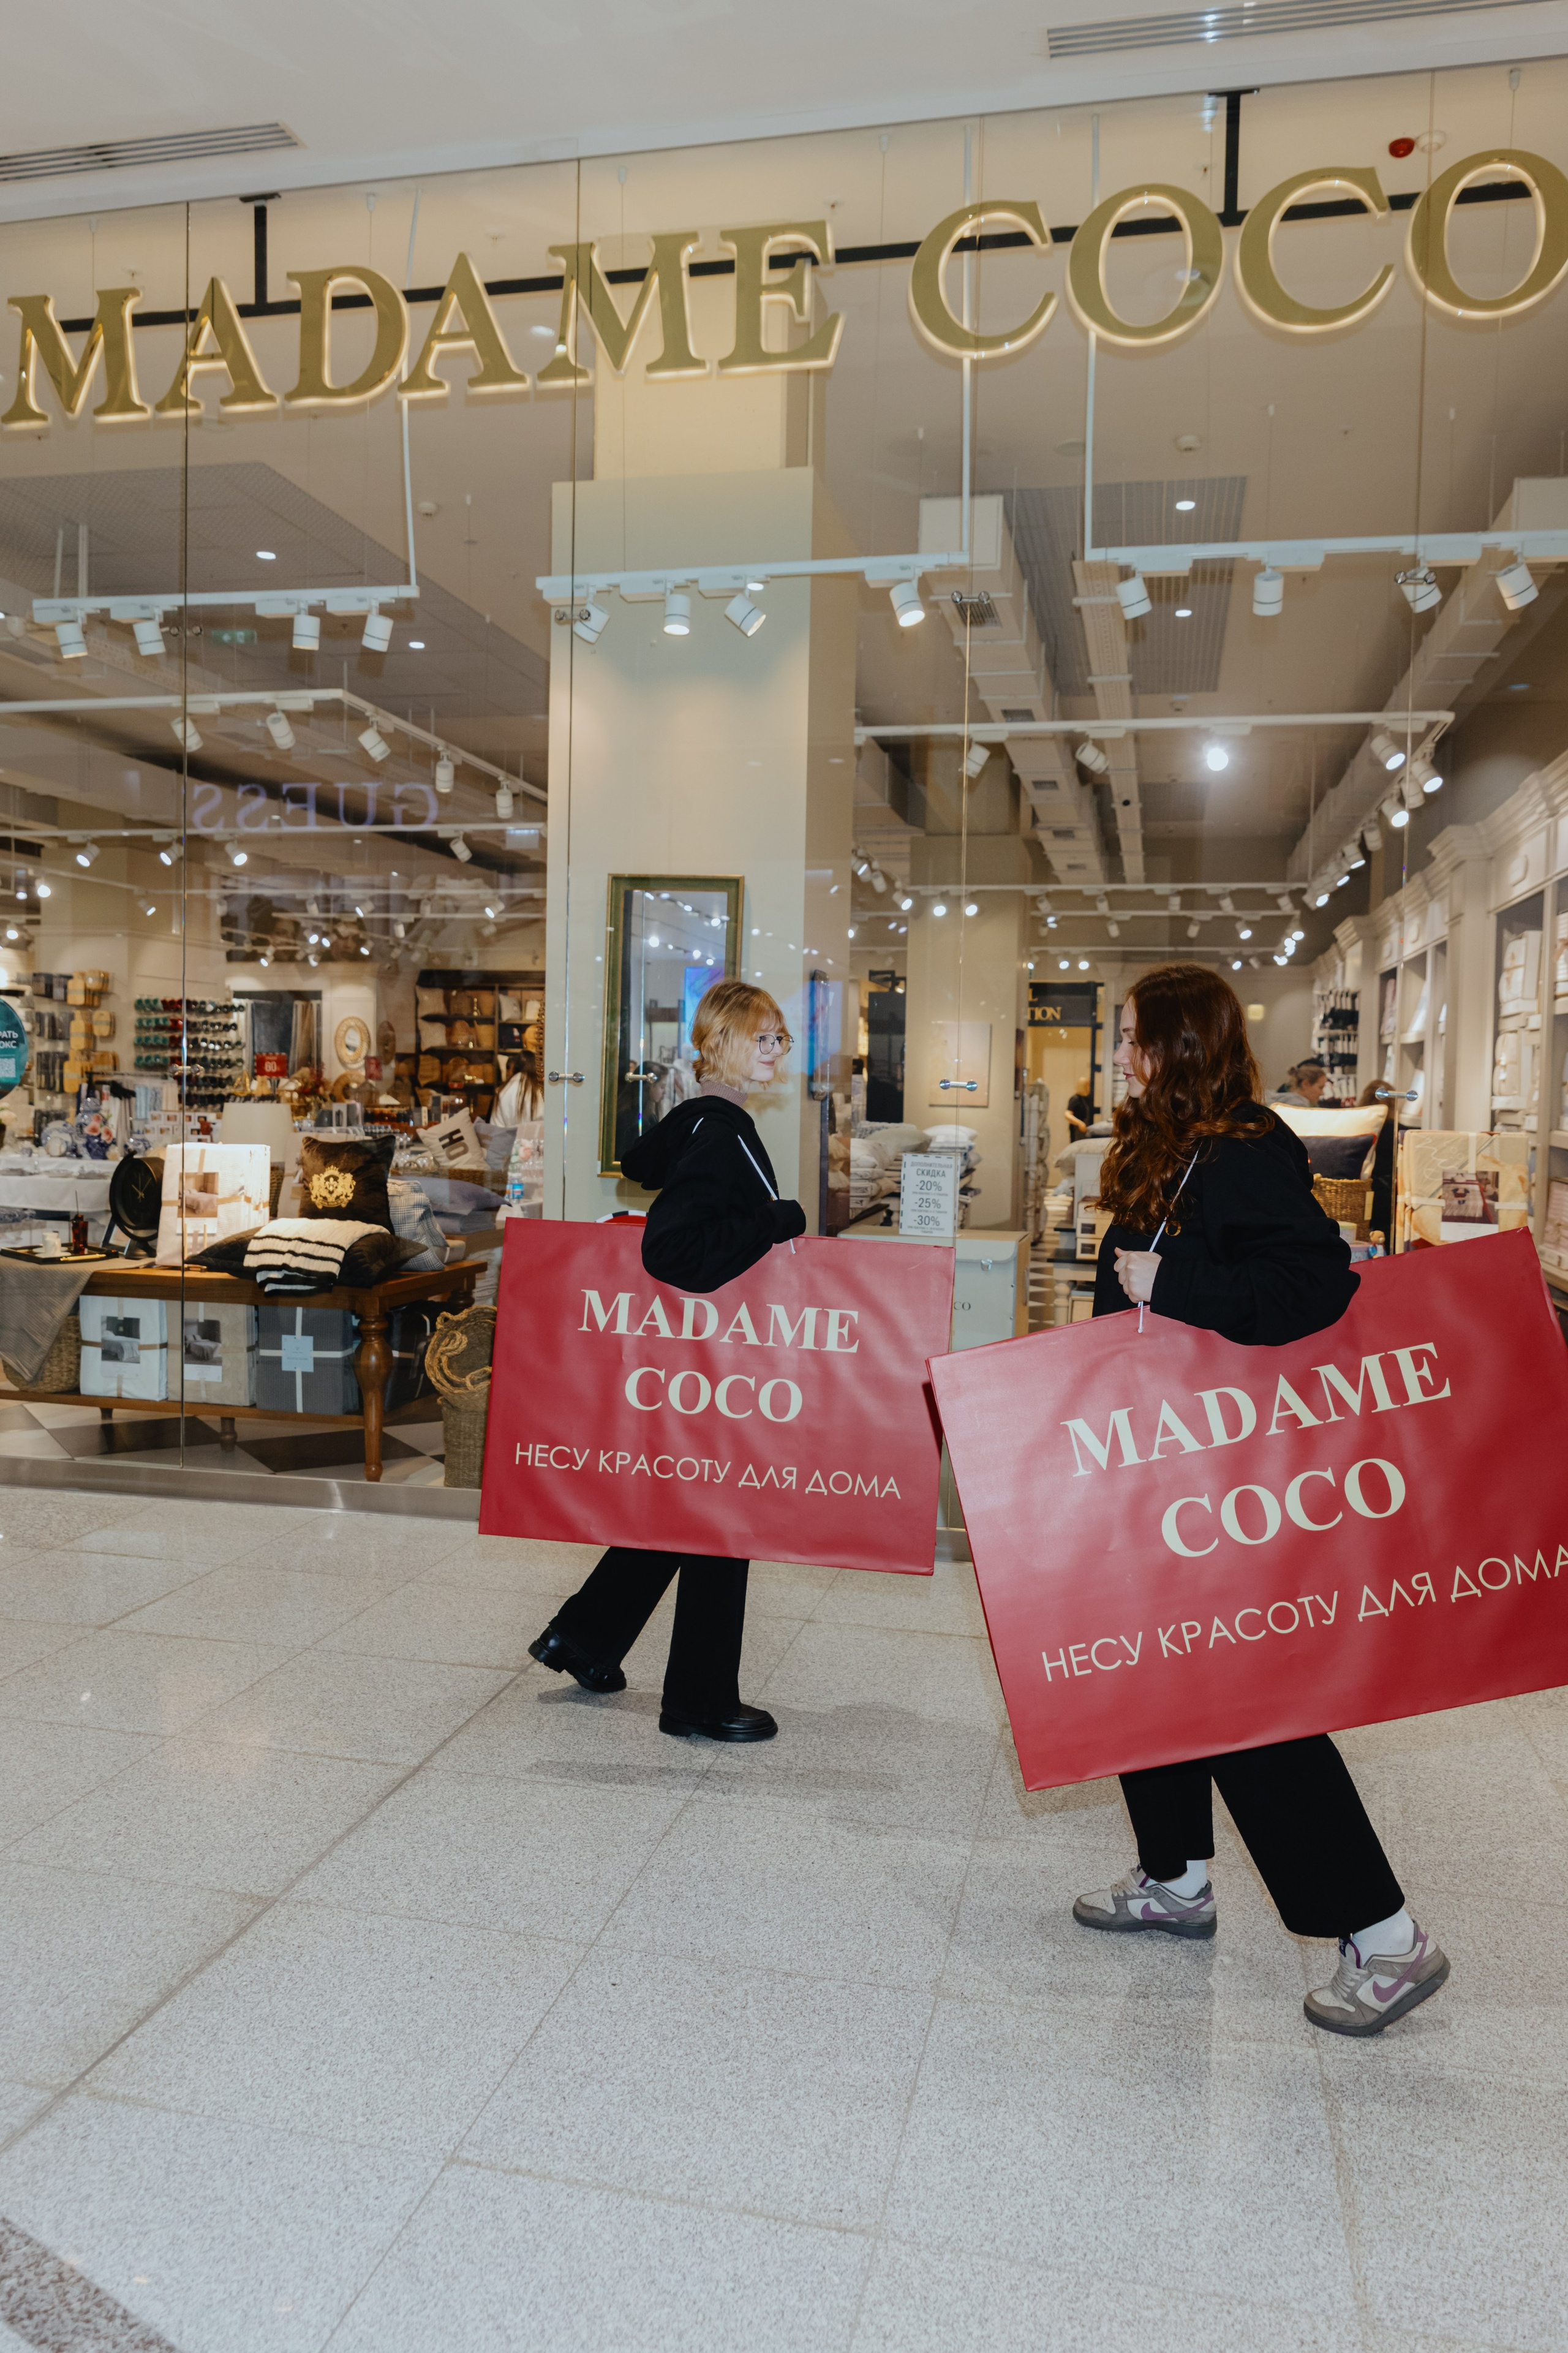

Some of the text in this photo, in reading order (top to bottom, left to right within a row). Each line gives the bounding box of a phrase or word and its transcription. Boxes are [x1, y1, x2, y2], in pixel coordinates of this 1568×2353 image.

[2, 148, 1568, 426] MADAME COCO
[916, 1168, 946, 1177] СКИДКА
[916, 1180, 942, 1192] -20%
[913, 1215, 940, 1226] -30%
[914, 1198, 941, 1209] -25%
[578, 1289, 859, 1353] MADAME
[625, 1367, 803, 1422] COCO
[1060, 1342, 1451, 1478] MADAME
[515, 1443, 902, 1500] НЕСУ КРАСОТУ ДЛЯ ДОМА
[1161, 1458, 1406, 1557] COCO
[1041, 1544, 1568, 1682] НЕСУ КРАСОТУ ДЛЯ ДОМА
